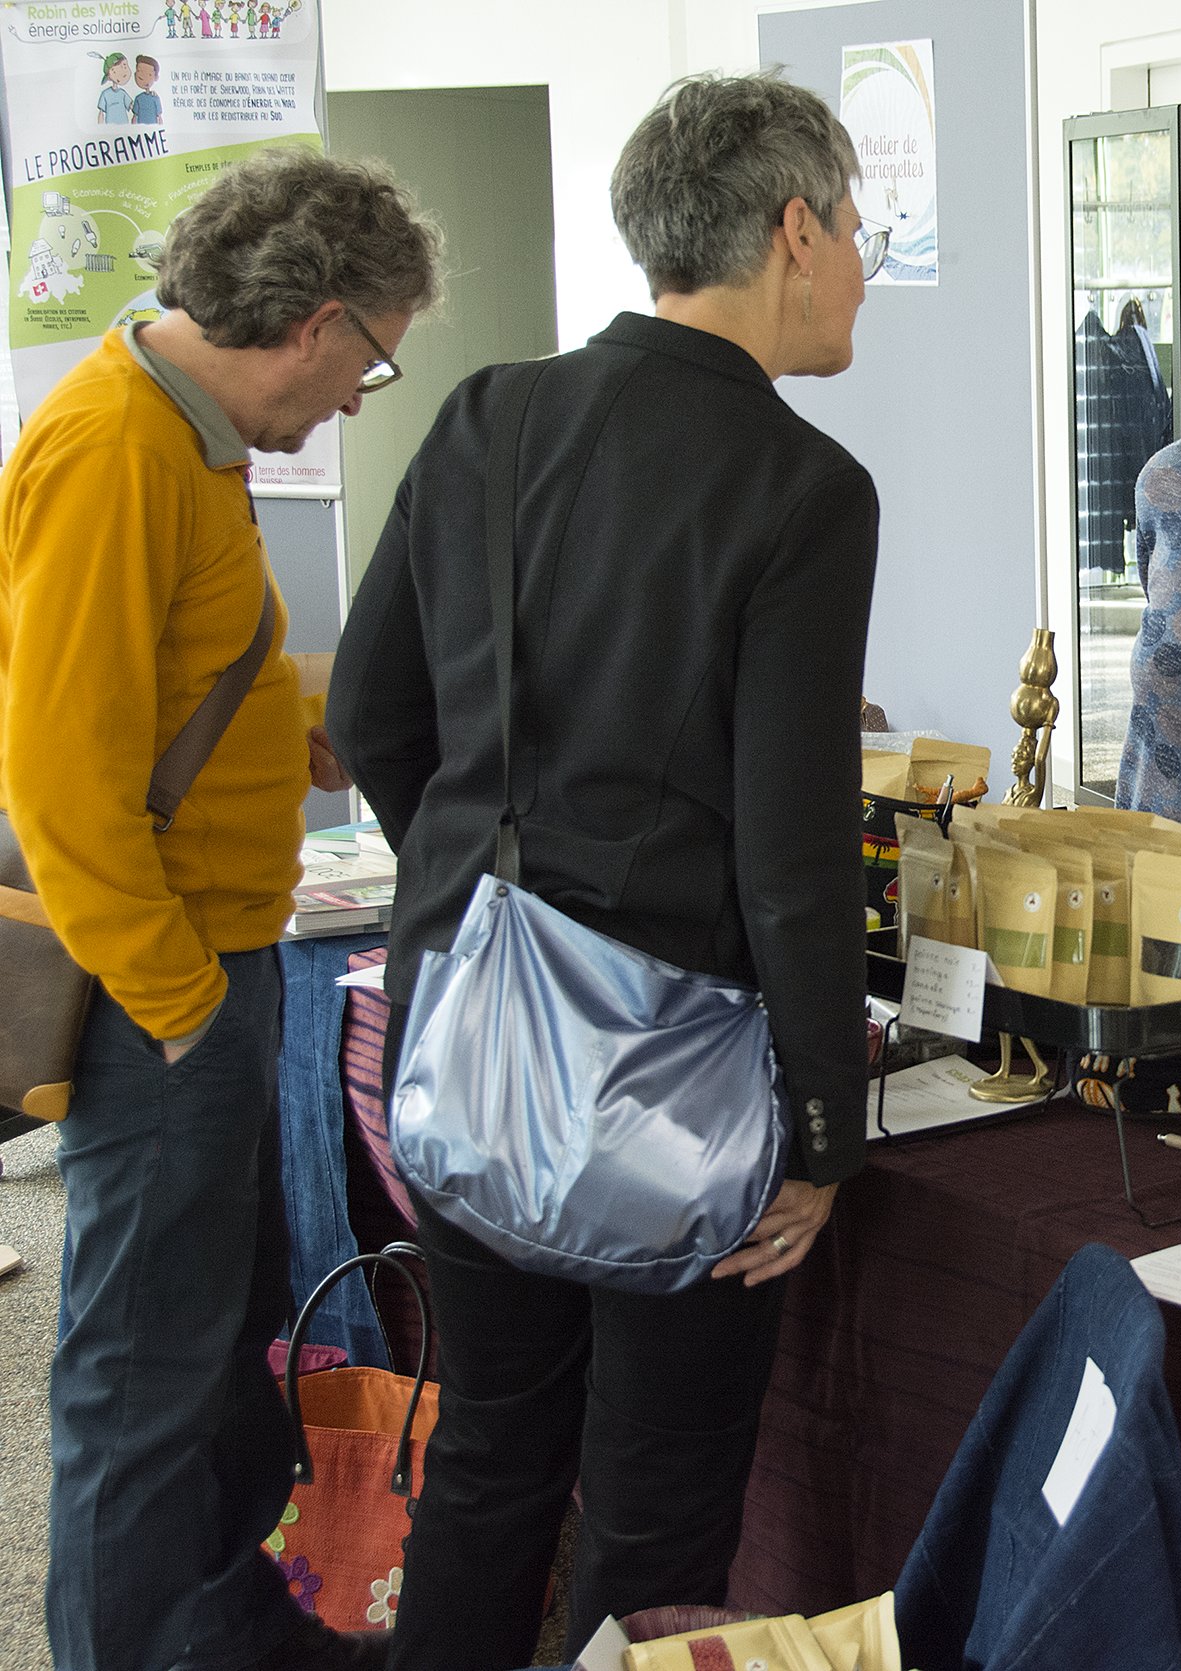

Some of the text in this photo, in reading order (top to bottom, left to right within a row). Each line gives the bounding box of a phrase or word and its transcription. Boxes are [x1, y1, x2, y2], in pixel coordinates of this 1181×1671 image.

[27, 2, 140, 20] Robin des Watts
[28, 18, 141, 40] énergie solidaire
[170, 71, 180, 81] UN
[181, 71, 191, 81] PEU
[225, 72, 233, 81] DU
[171, 85, 178, 94] DE
[181, 85, 189, 94] LA
[210, 85, 218, 94] DE
[276, 85, 296, 95] WATTS
[196, 98, 208, 108] DES
[208, 111, 219, 120] LES
[261, 112, 268, 120] AU
[858, 134, 918, 159] Atelier de
[24, 129, 169, 182] LE PROGRAMME
[259, 466, 326, 477] terre des hommes
